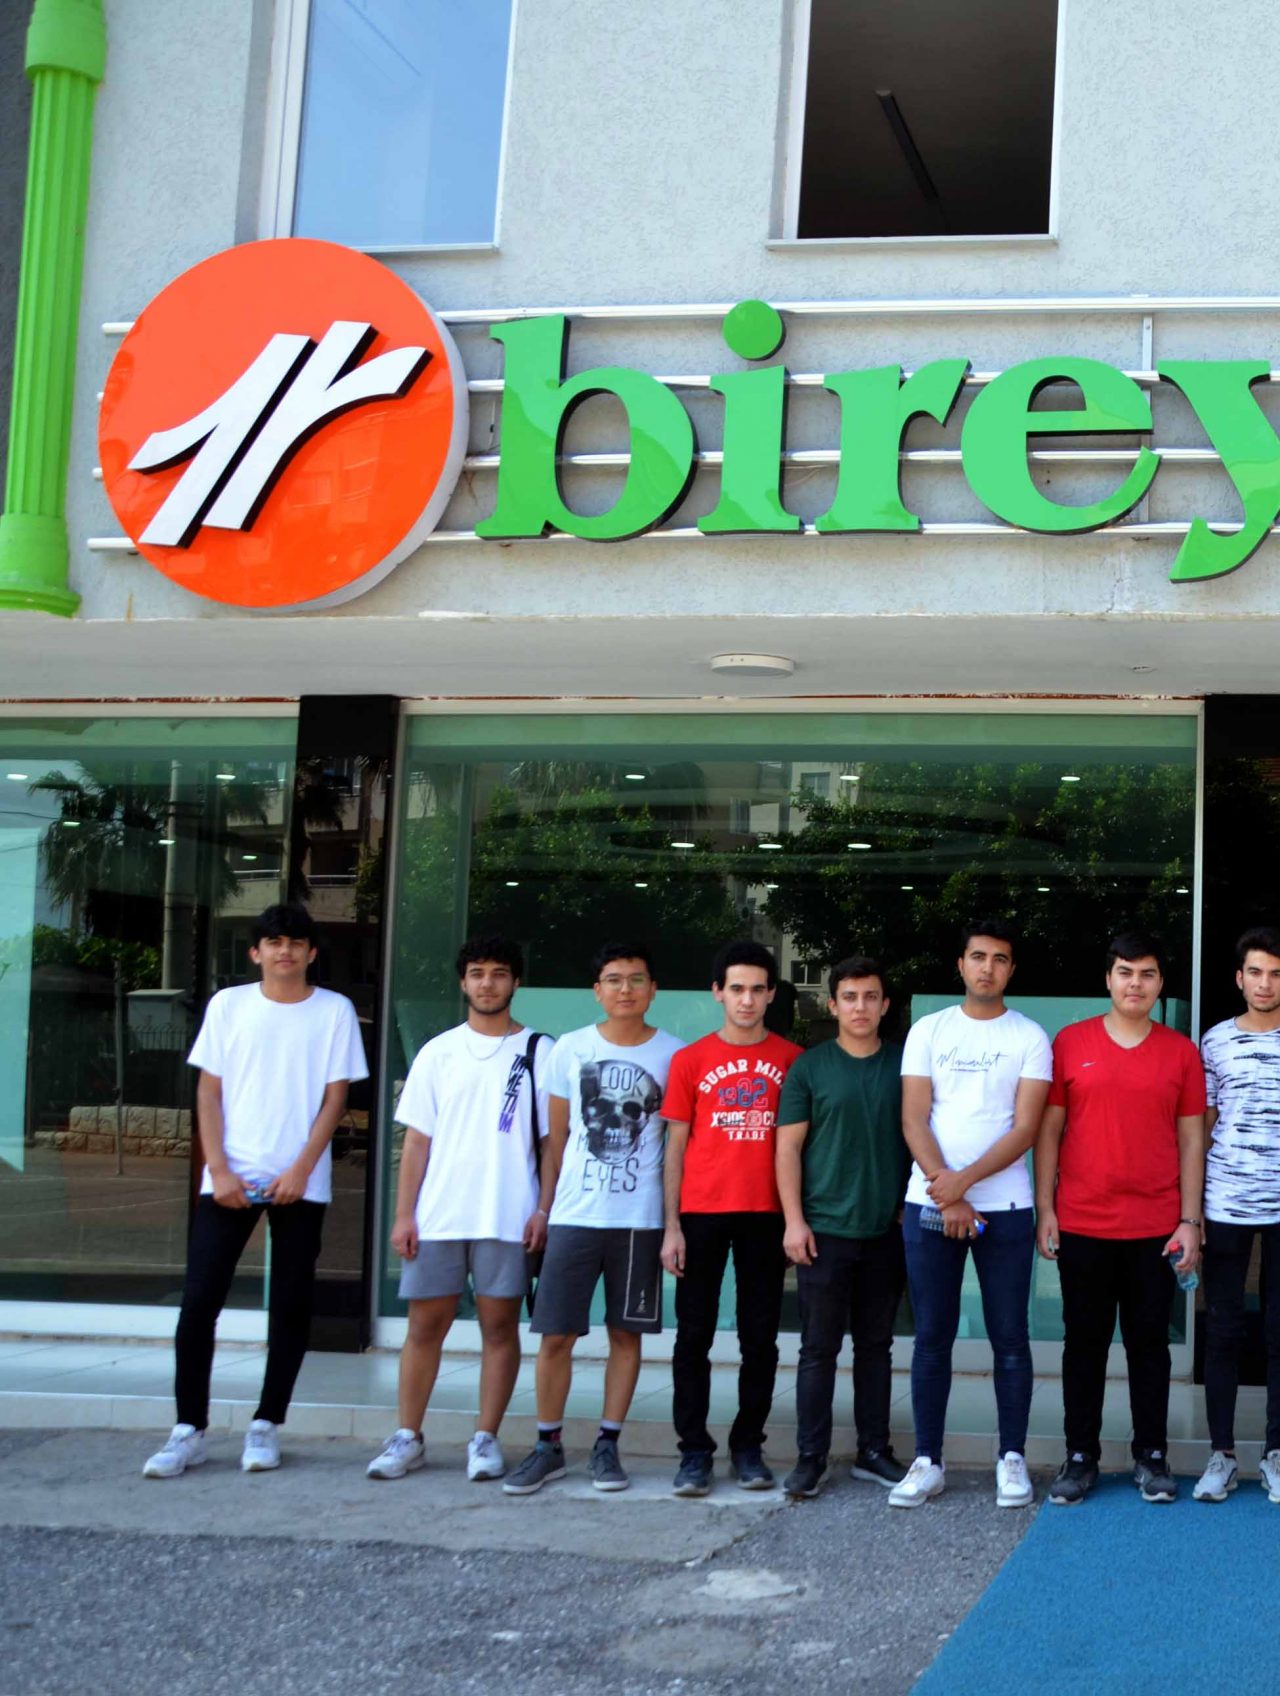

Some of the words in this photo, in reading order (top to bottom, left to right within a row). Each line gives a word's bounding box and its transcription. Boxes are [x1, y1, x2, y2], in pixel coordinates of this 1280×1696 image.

[600, 1066, 646, 1097] LOOK
[698, 1059, 748, 1094] SUGAR
[582, 1157, 639, 1192] EYES
